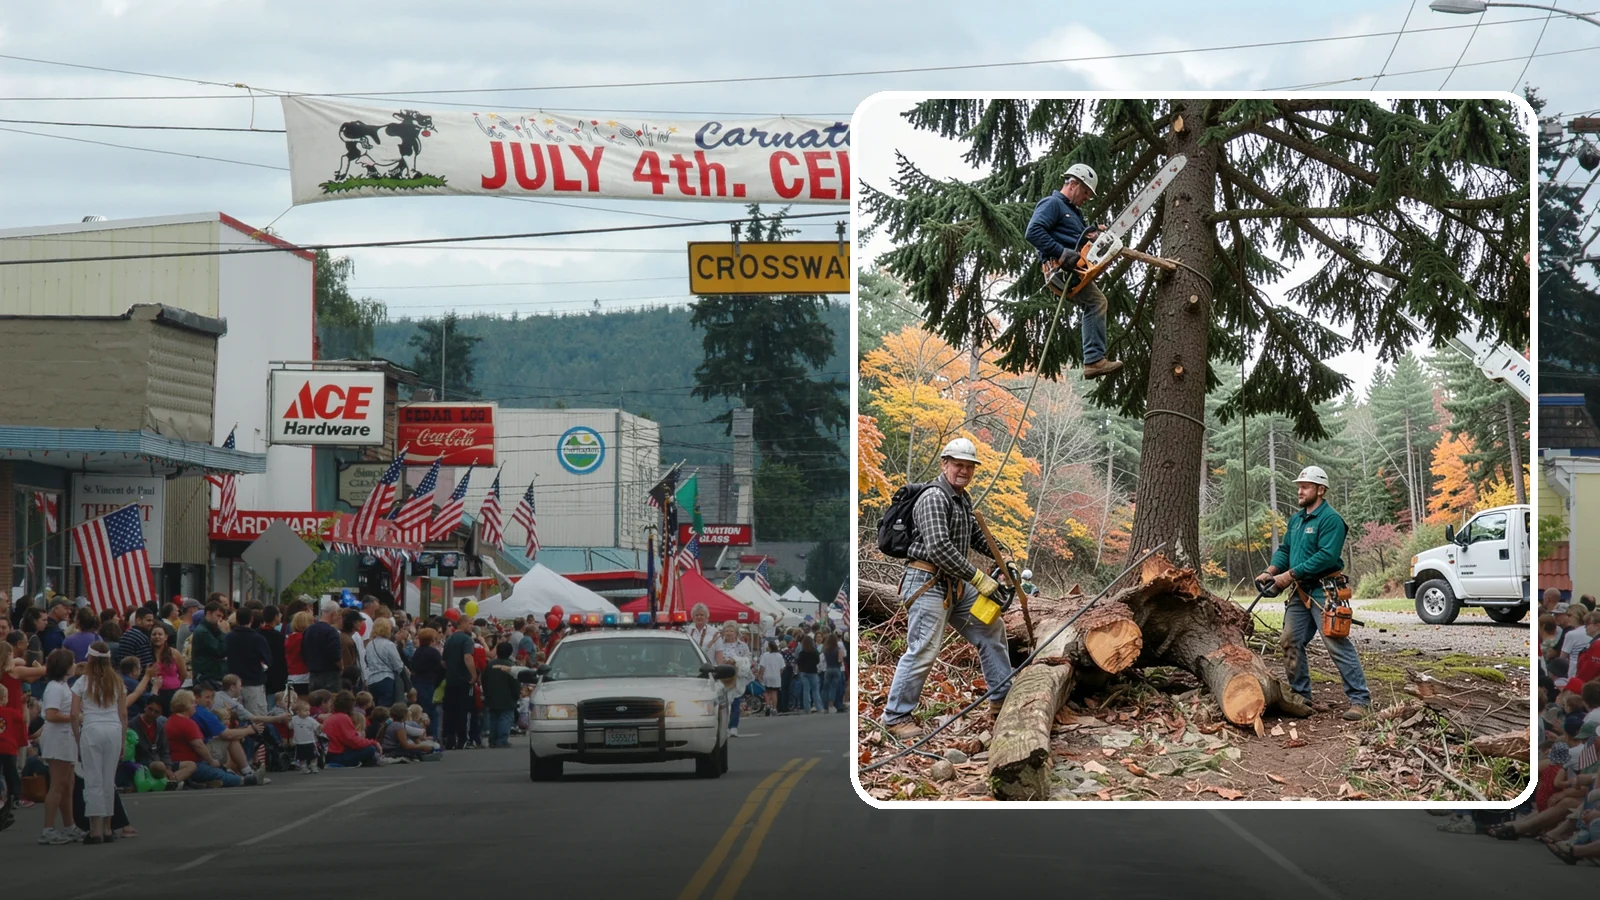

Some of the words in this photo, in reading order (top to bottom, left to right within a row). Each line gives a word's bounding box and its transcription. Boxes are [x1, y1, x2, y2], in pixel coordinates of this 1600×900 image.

[694, 121, 850, 150] Carnat
[481, 140, 605, 192] JULY
[632, 150, 746, 198] 4th.
[697, 254, 850, 280] CROSSWA
[282, 380, 373, 420] ACE
[405, 409, 453, 422] CEDAR
[283, 421, 370, 436] Hardware
[416, 428, 477, 447] Coca-Cola
[353, 467, 388, 480] Simpl
[83, 484, 94, 494] St.
[95, 484, 124, 495] Vincent
[126, 485, 136, 495] de
[137, 485, 155, 495] Paul
[213, 516, 331, 535] HARDARE
[688, 526, 742, 535] CRNATION
[699, 535, 730, 543] GLASS
